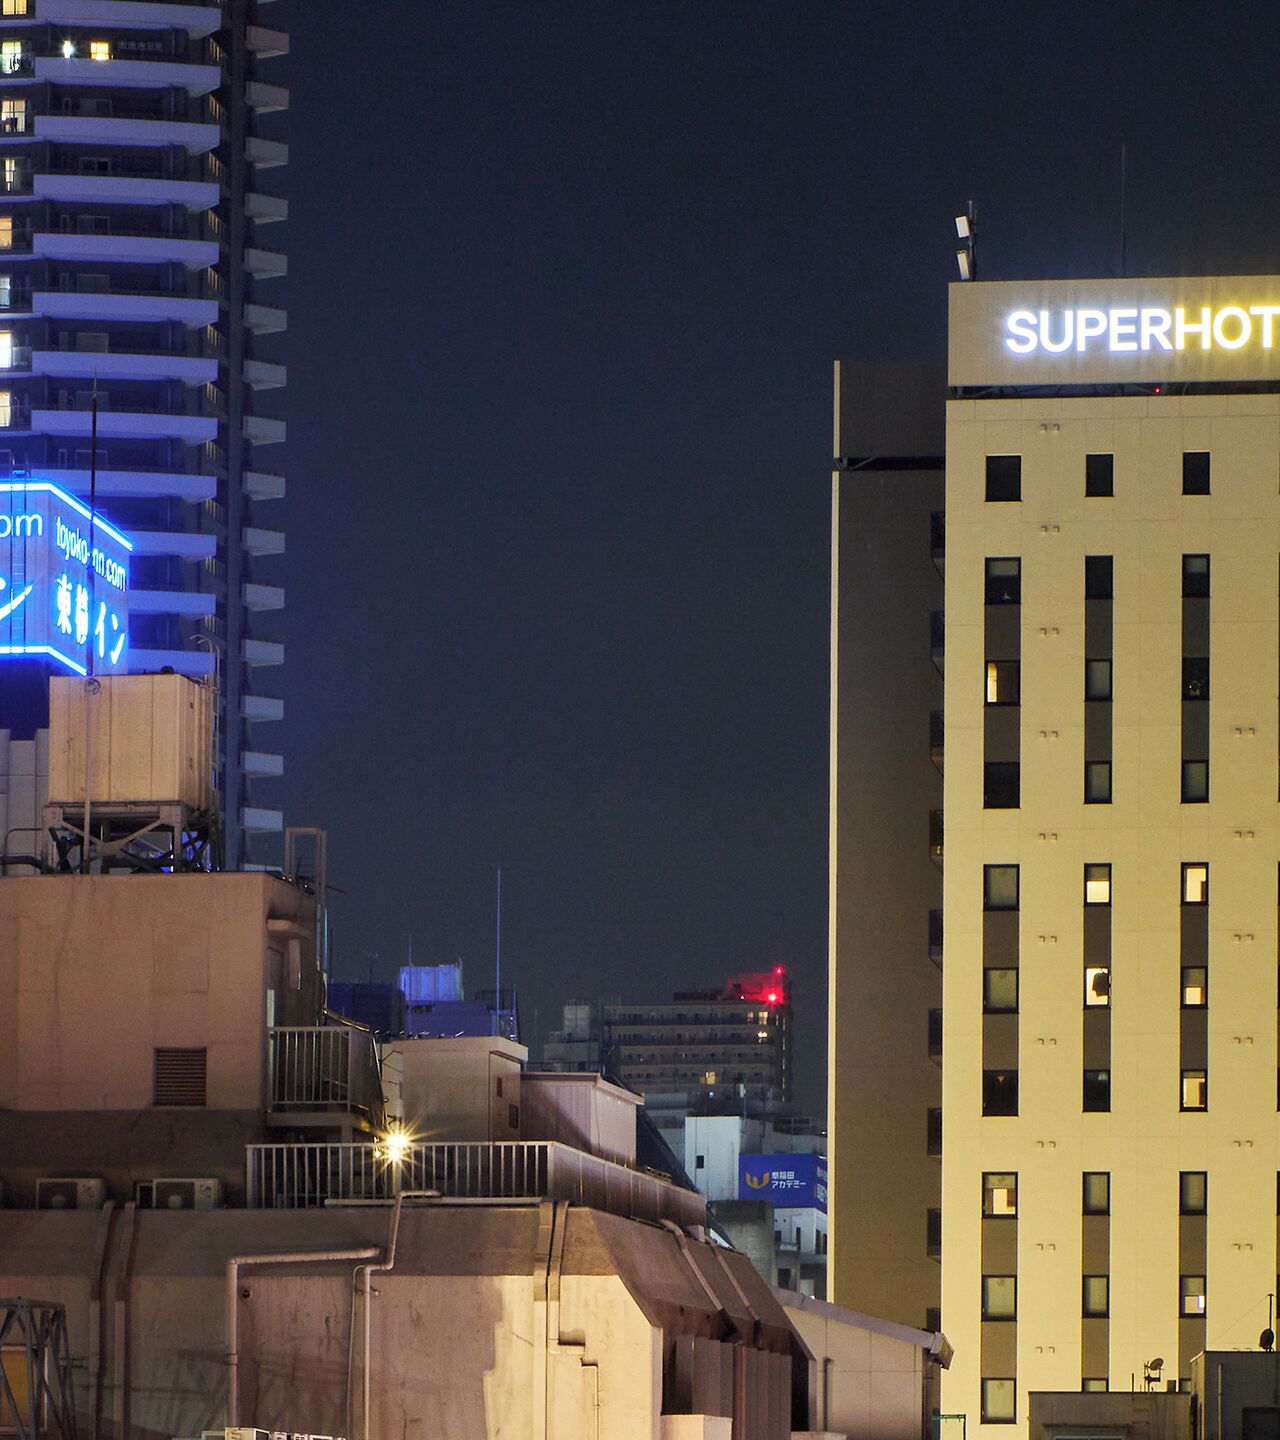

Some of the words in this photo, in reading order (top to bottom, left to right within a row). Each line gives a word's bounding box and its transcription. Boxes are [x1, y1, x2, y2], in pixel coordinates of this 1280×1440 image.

[55, 515, 127, 593] toyoko-nn.com
[55, 572, 126, 665] 東横イン
[771, 1180, 806, 1189] アカデミー
